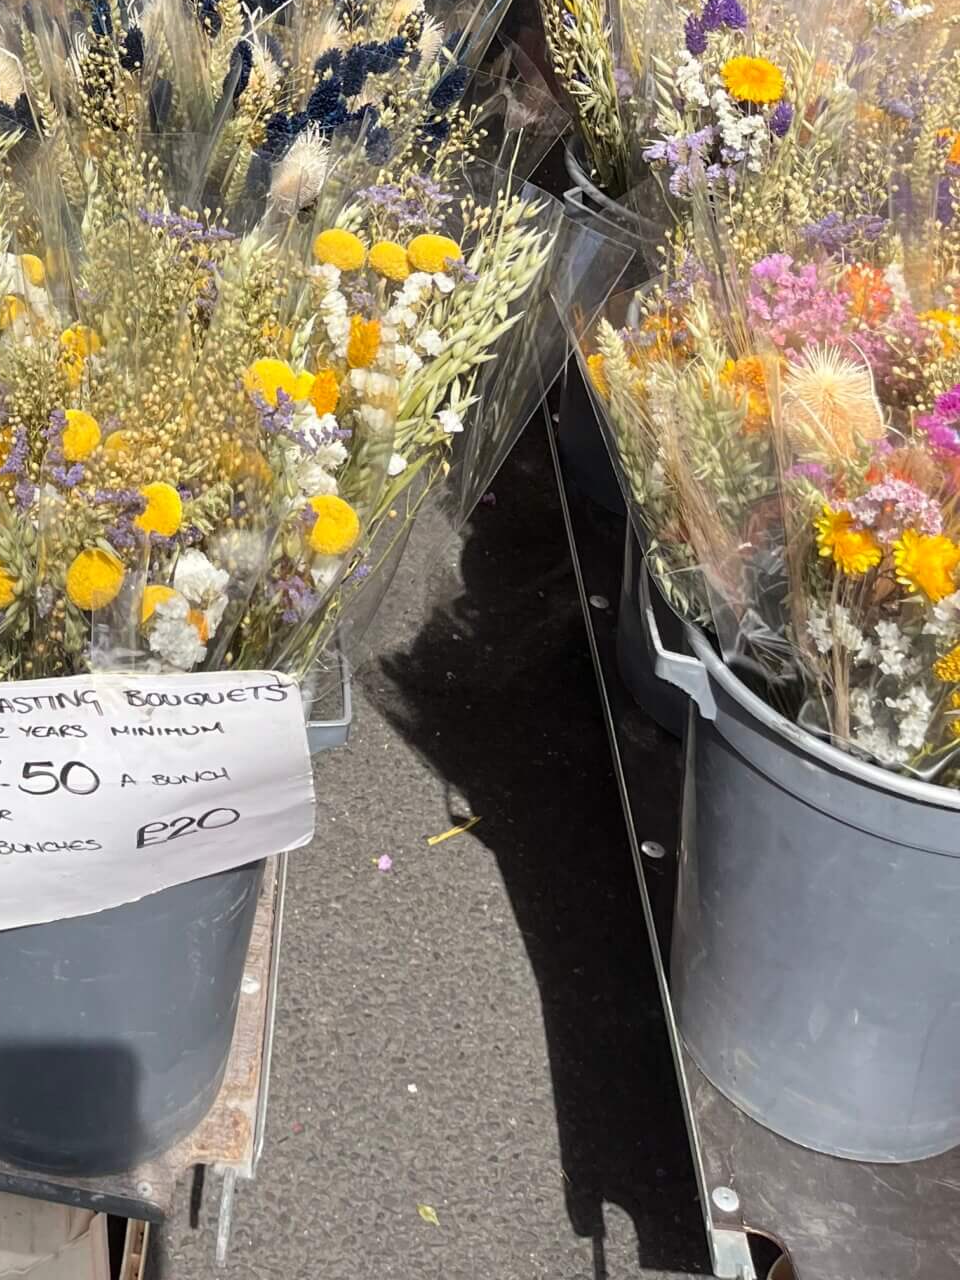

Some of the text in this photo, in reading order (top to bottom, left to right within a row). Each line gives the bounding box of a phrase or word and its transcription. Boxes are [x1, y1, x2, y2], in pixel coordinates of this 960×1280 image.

[127, 683, 292, 708] BOUQUETS
[19, 725, 89, 739] YEARS
[110, 722, 225, 738] MINIMUM
[120, 774, 137, 788] A
[152, 766, 231, 787] BUNCH
[136, 807, 241, 850] £20
